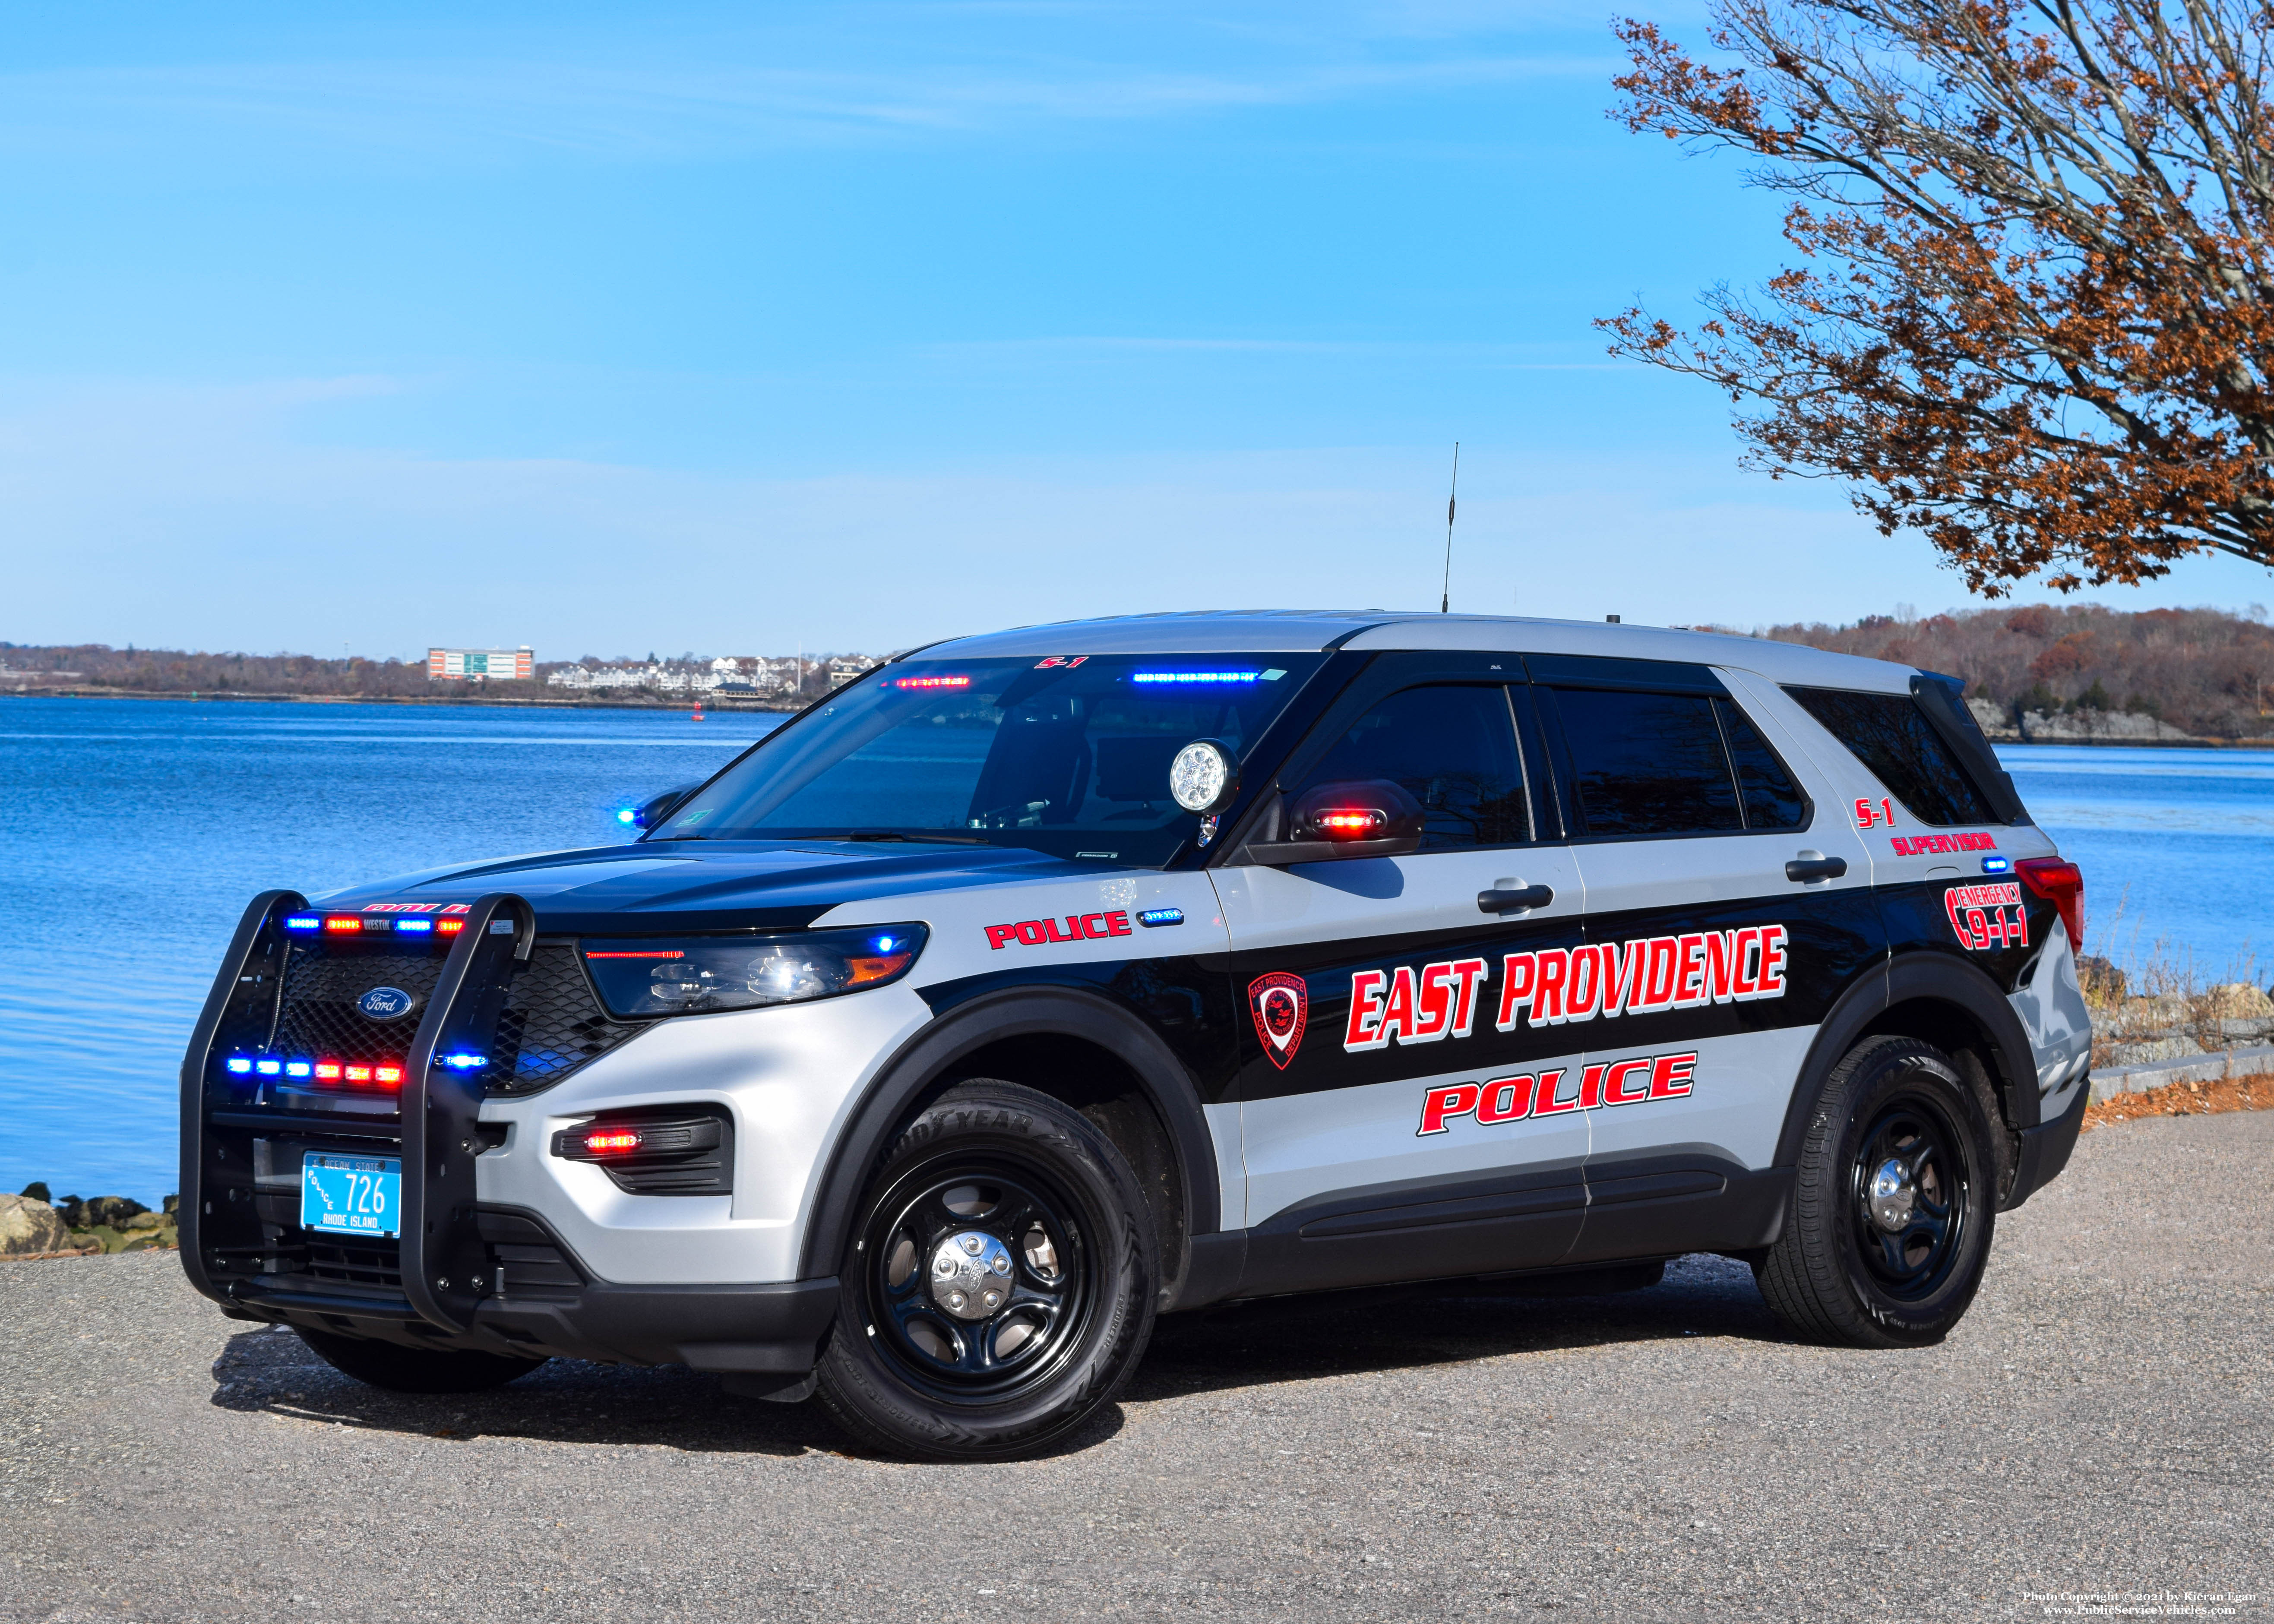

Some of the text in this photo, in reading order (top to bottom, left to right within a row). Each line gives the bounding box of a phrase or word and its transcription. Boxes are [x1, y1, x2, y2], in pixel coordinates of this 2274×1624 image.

[1034, 656, 1089, 669] S-1
[1854, 796, 1896, 829] S-1
[1891, 832, 1997, 856] SUPERVISOR
[1956, 882, 2023, 909] EMERGENCY
[984, 910, 1132, 950] POLICE
[1966, 904, 2029, 950] 9-1-1
[367, 993, 397, 1011] Ford
[1251, 976, 1304, 998] EAST PROVIDENCE
[1343, 924, 1788, 1053] EAST PROVIDENCE
[1255, 1011, 1273, 1050] POLICE
[1285, 995, 1305, 1057] DEPARTMENT
[1415, 1050, 1699, 1137] POLICE
[324, 1160, 349, 1170] OCEAN
[356, 1162, 380, 1172] STATE
[308, 1170, 333, 1210] POLICE
[346, 1174, 385, 1213] 726
[323, 1213, 377, 1229] RHODE ISLAND
[1103, 1293, 1125, 1348] ENFORCER
